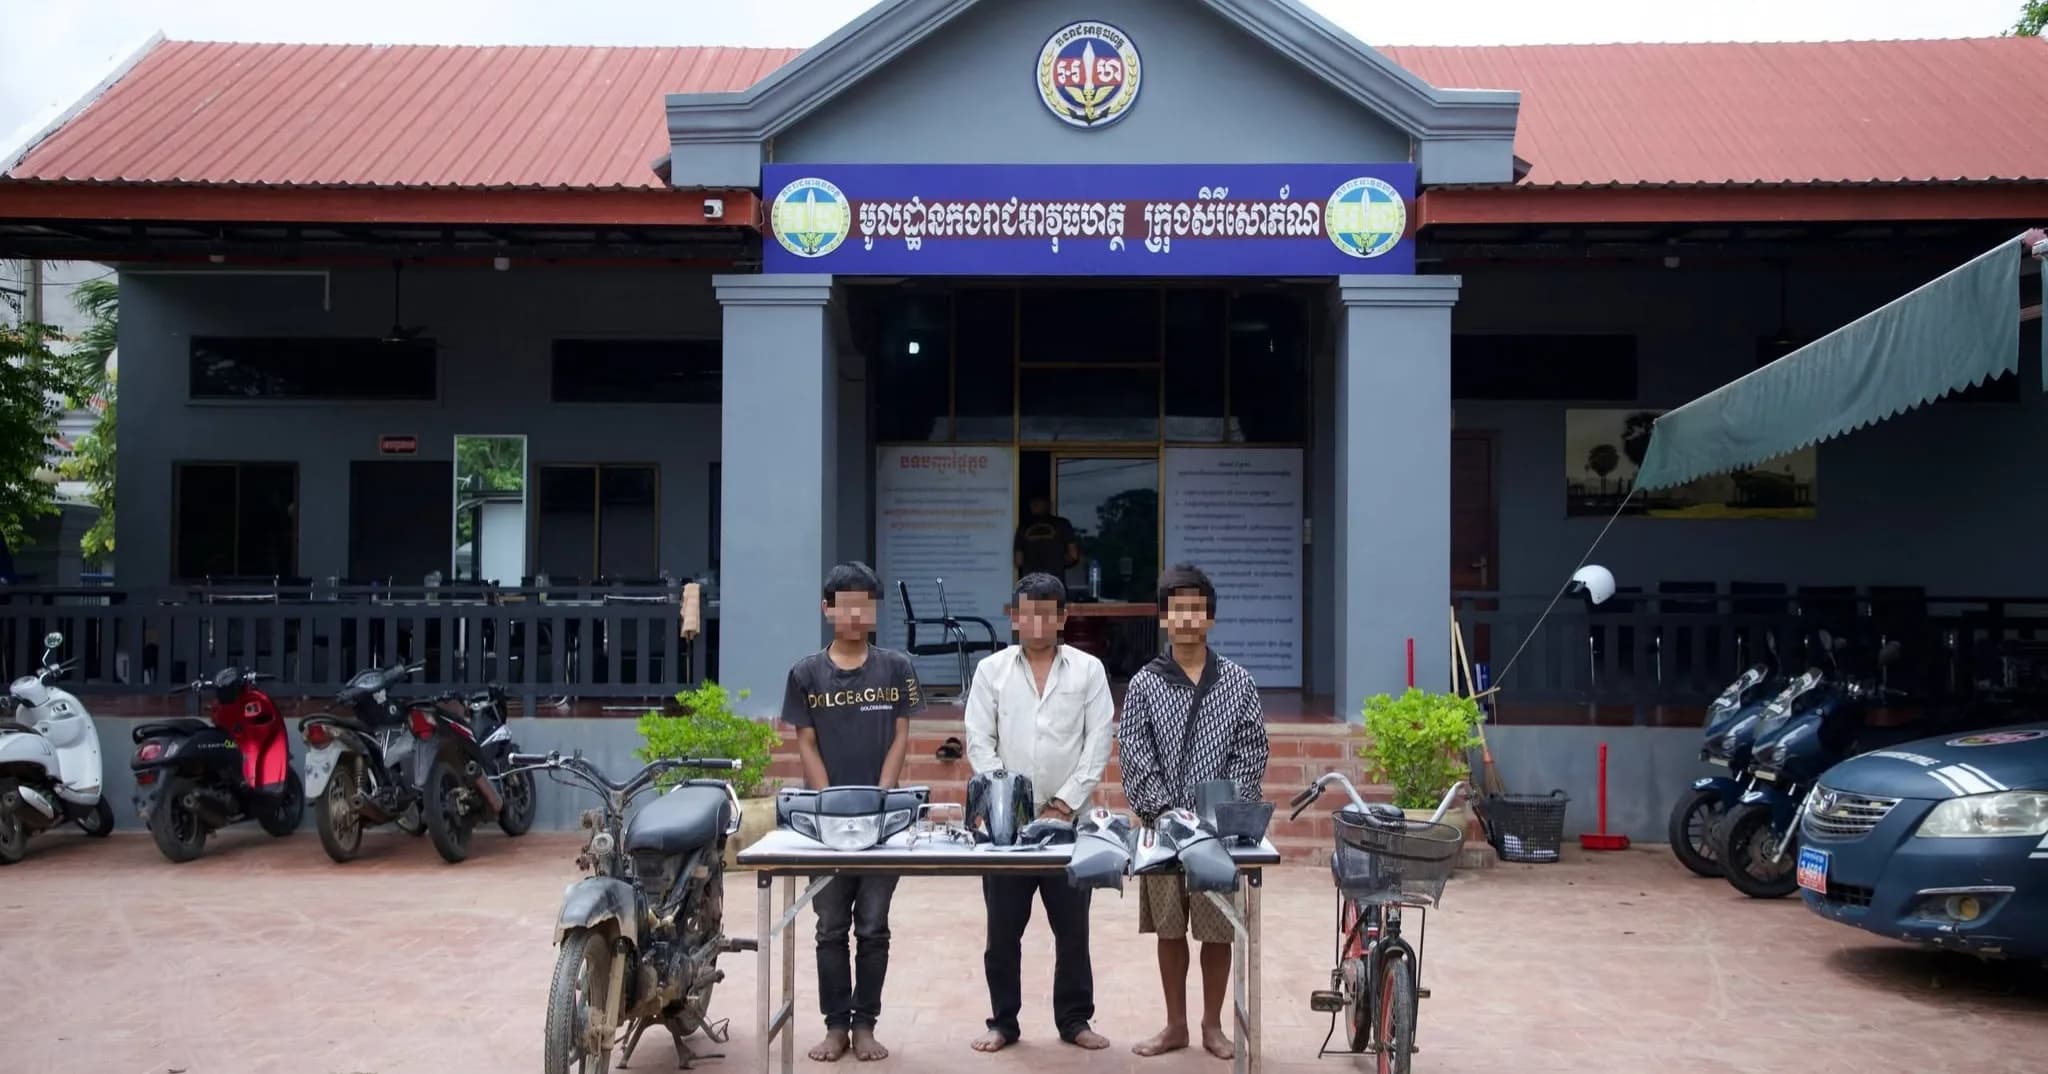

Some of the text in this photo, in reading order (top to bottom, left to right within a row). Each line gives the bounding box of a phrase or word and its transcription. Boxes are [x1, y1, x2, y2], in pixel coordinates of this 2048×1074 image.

[1144, 184, 1320, 254] ក្រុងសិរីសោភ័ណ
